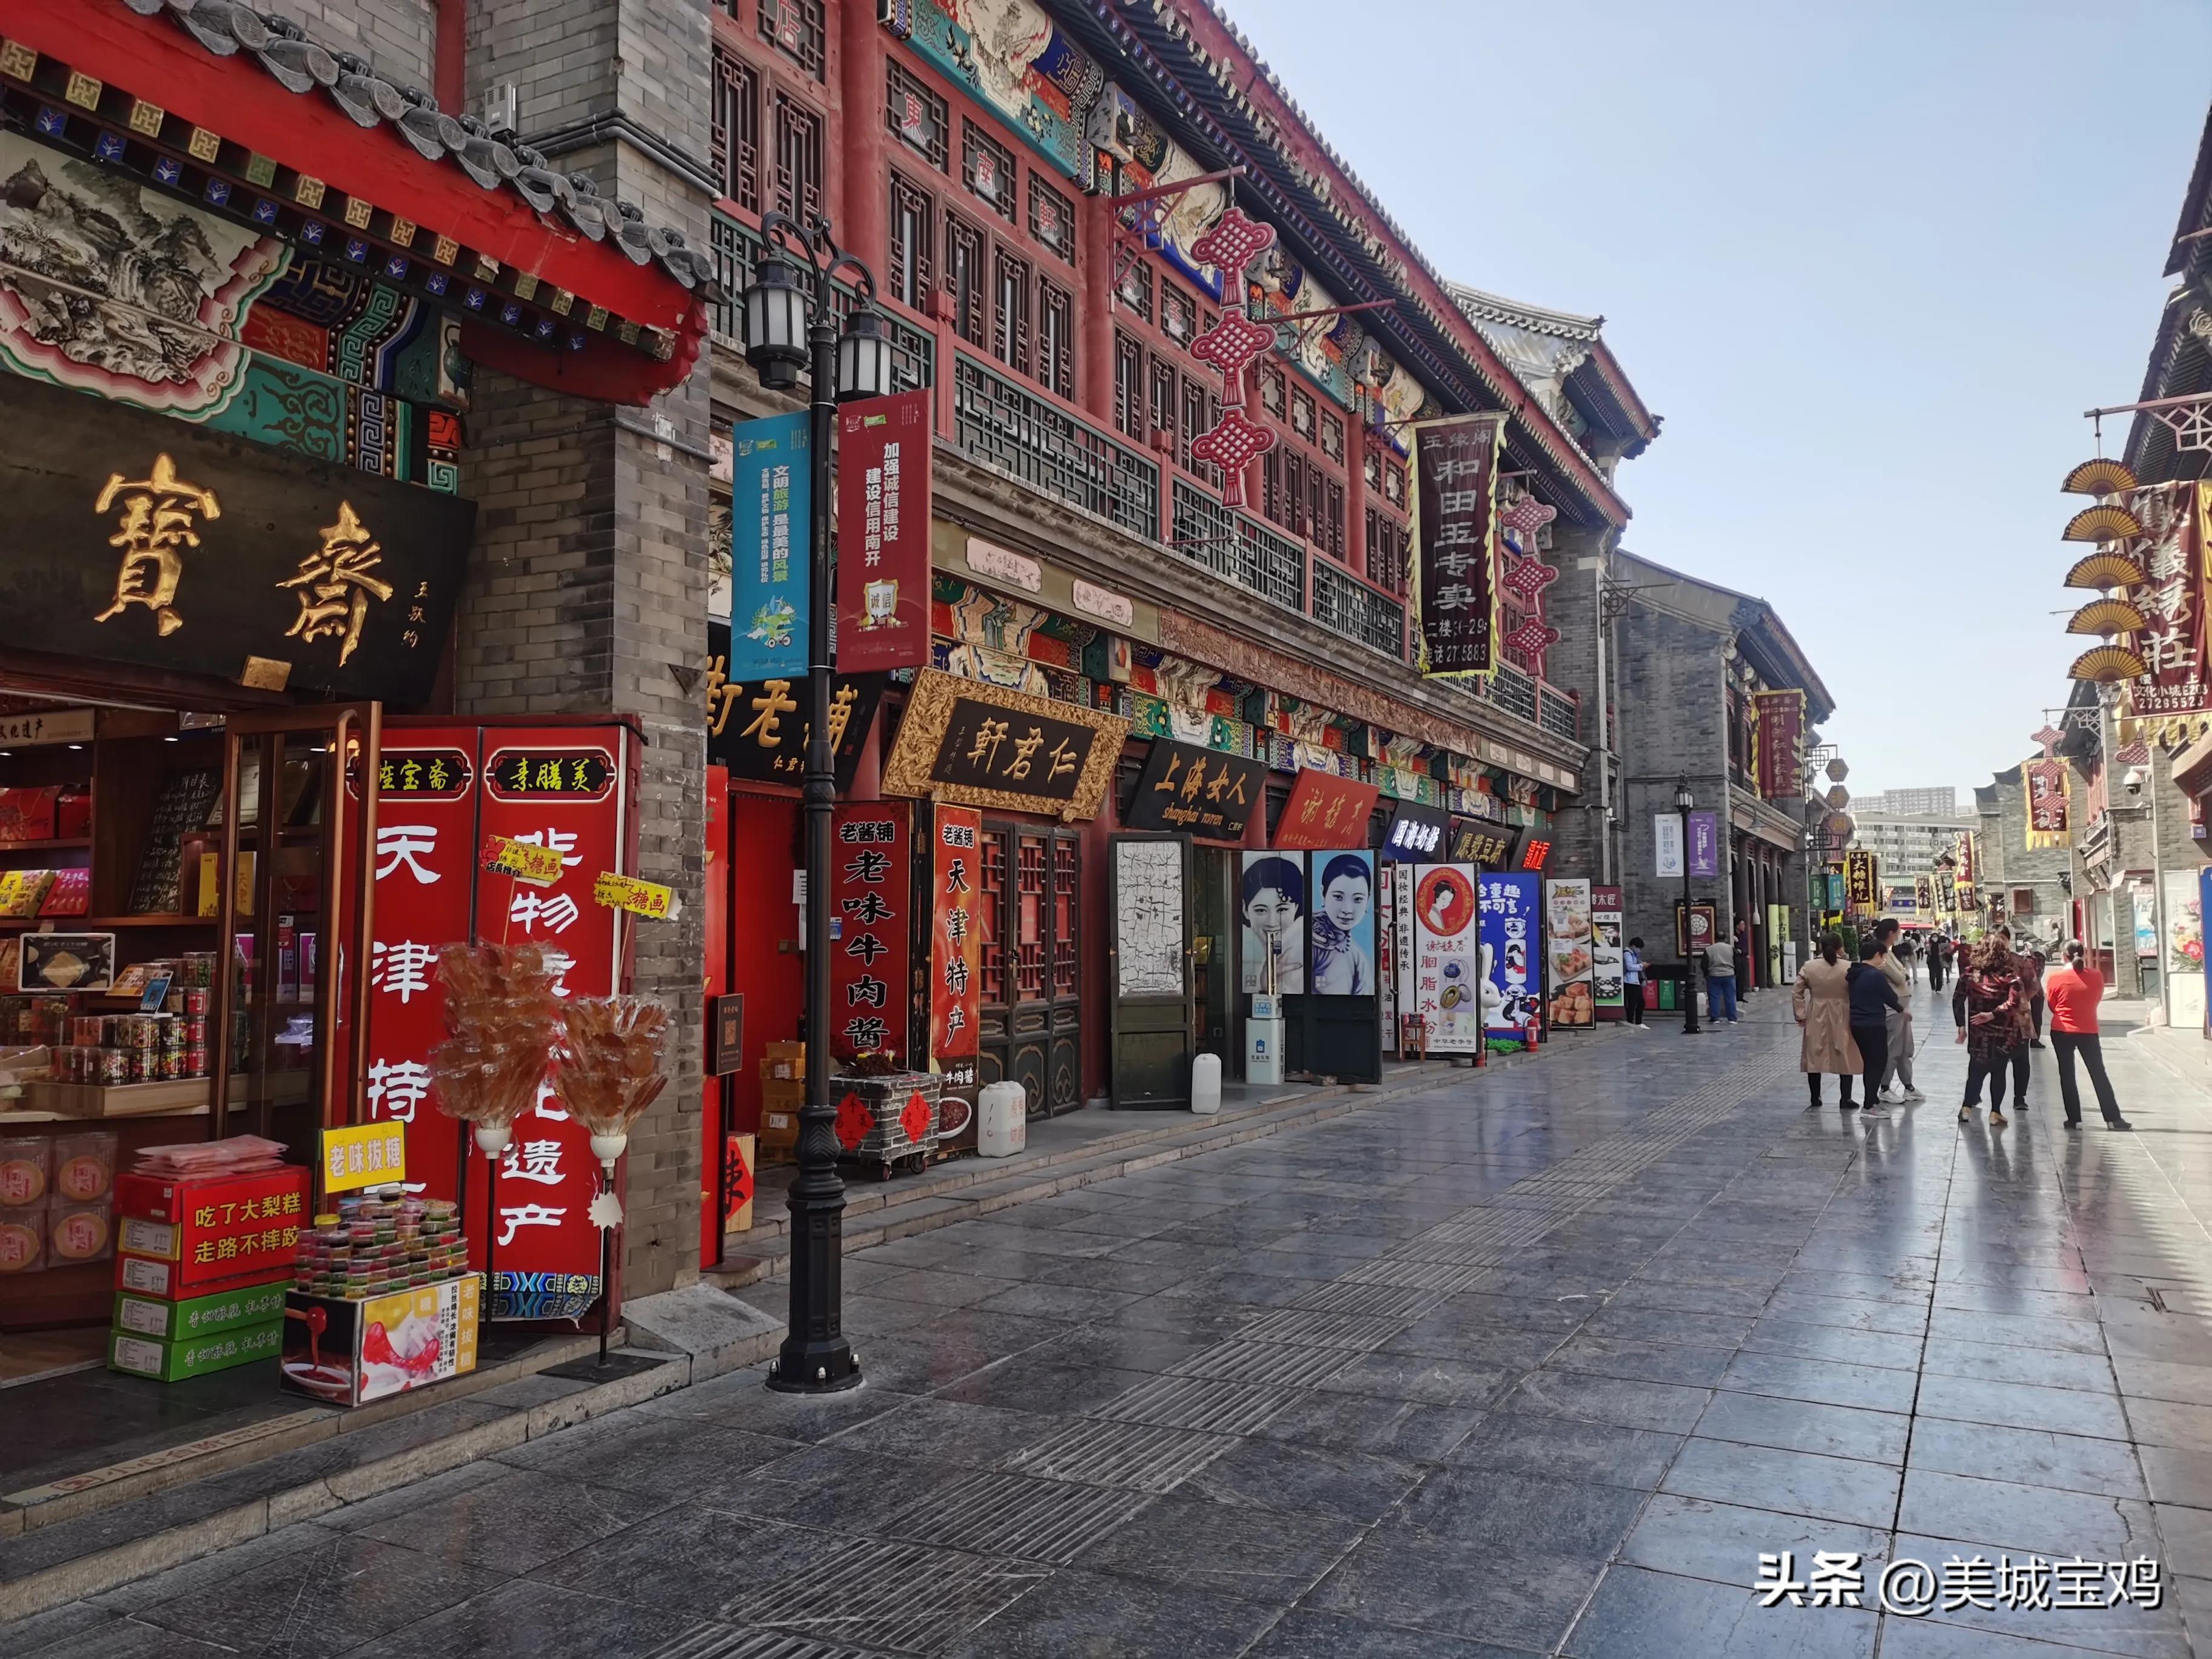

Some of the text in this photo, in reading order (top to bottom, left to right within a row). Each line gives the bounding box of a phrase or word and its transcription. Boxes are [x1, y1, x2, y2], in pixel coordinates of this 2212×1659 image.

[883, 442, 900, 542] 加强诚信建设
[772, 464, 789, 583] 文明旅游 是最美的风景
[865, 467, 882, 568] 建设信用南开
[1432, 458, 1480, 611] 和田玉专卖
[871, 591, 893, 609] 诚信
[1155, 751, 1247, 805] 上海女人
[839, 821, 895, 844] 老酱铺
[942, 823, 975, 849] 老酱铺
[1162, 802, 1201, 827] shanghai
[529, 851, 559, 877] 糖画
[632, 887, 665, 914] 糖画
[1398, 869, 1409, 917] 国妆经典
[842, 849, 896, 1049] 老味牛肉酱
[945, 859, 971, 1048] 天津特产
[364, 824, 441, 1195] 天津特
[1419, 955, 1438, 1035] 胭脂水粉
[1433, 1037, 1474, 1046] 中华老字号
[944, 1068, 974, 1086] 牛肉酱
[328, 1134, 402, 1178] 老味拔糖
[195, 1191, 302, 1228] 吃了大梨糕
[193, 1225, 301, 1265] 走路不摔跤
[460, 1284, 475, 1369] 老味拔糖
